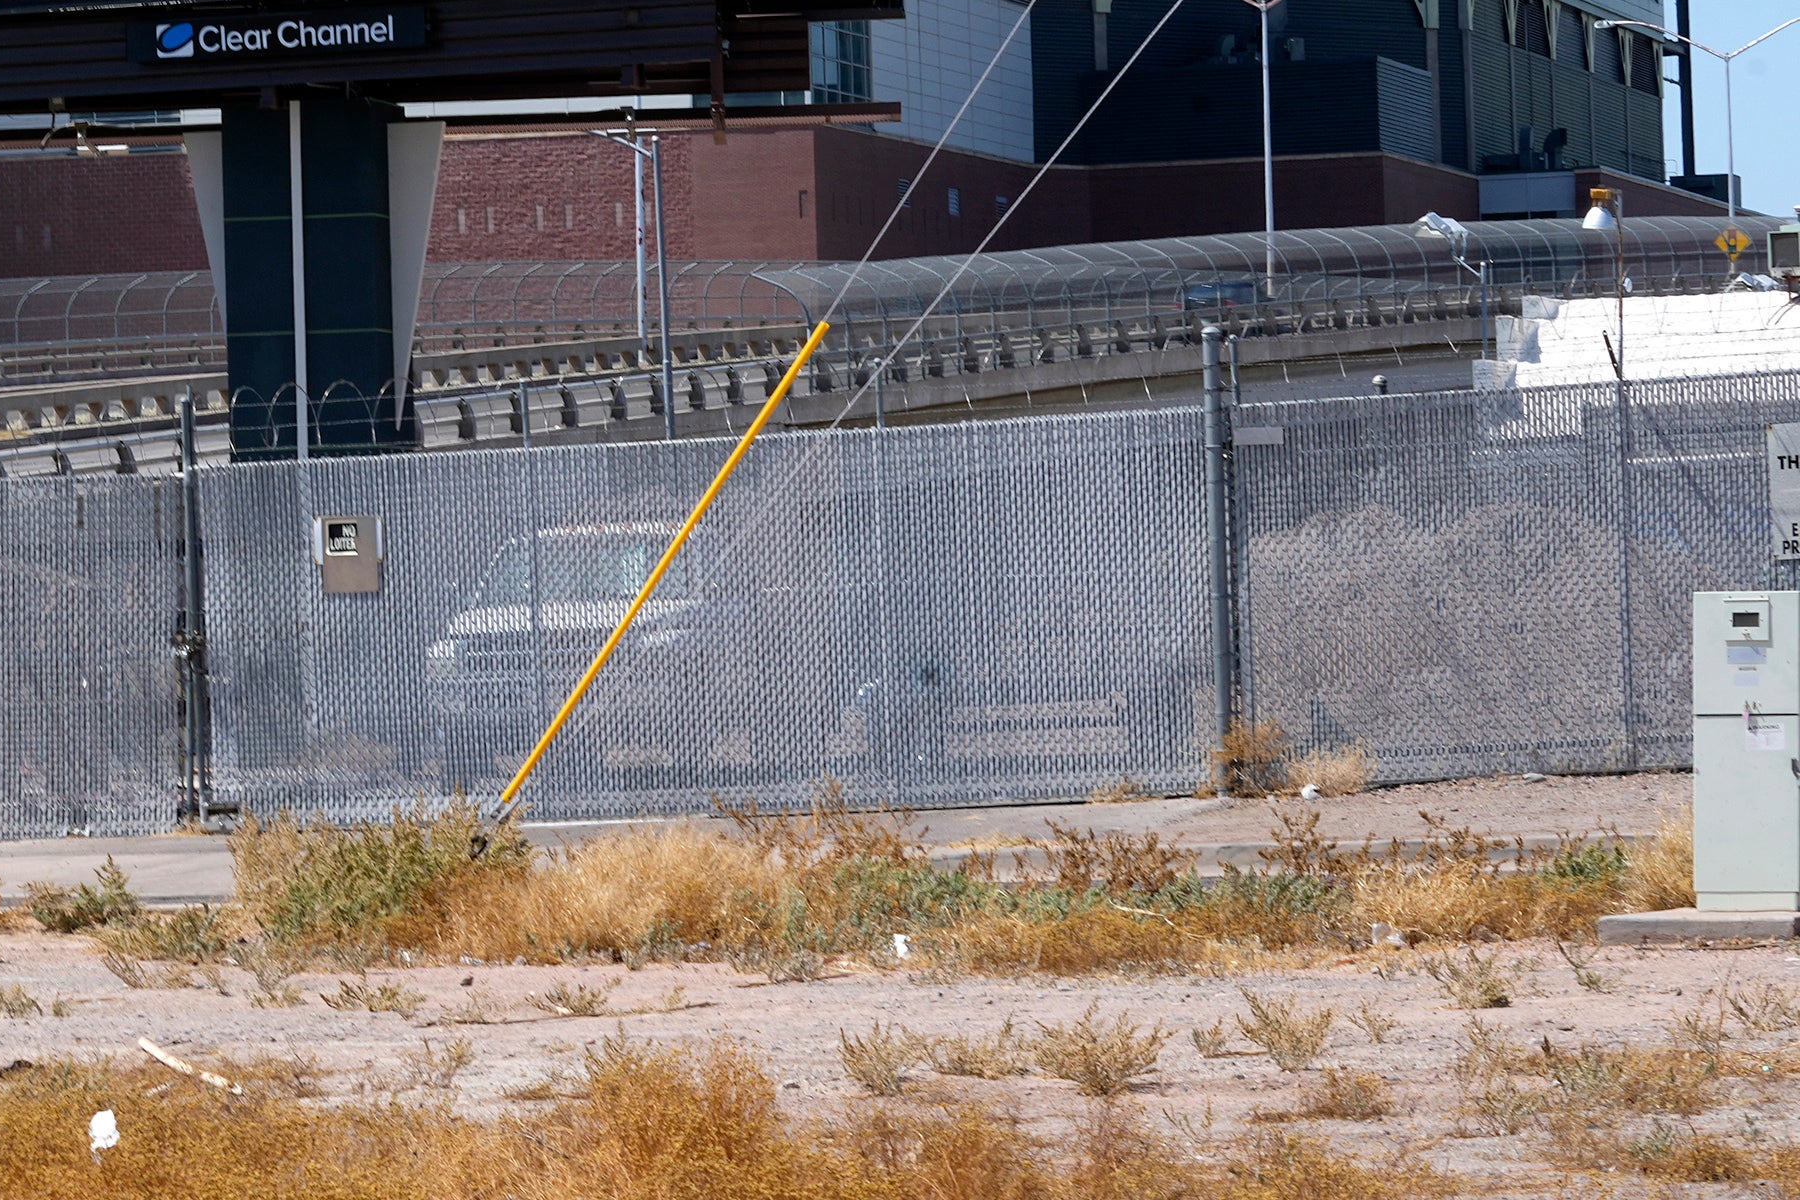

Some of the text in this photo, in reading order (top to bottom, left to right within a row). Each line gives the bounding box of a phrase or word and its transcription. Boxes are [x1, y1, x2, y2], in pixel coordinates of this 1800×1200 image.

[199, 15, 394, 55] Clear Channel
[342, 524, 356, 537] NO
